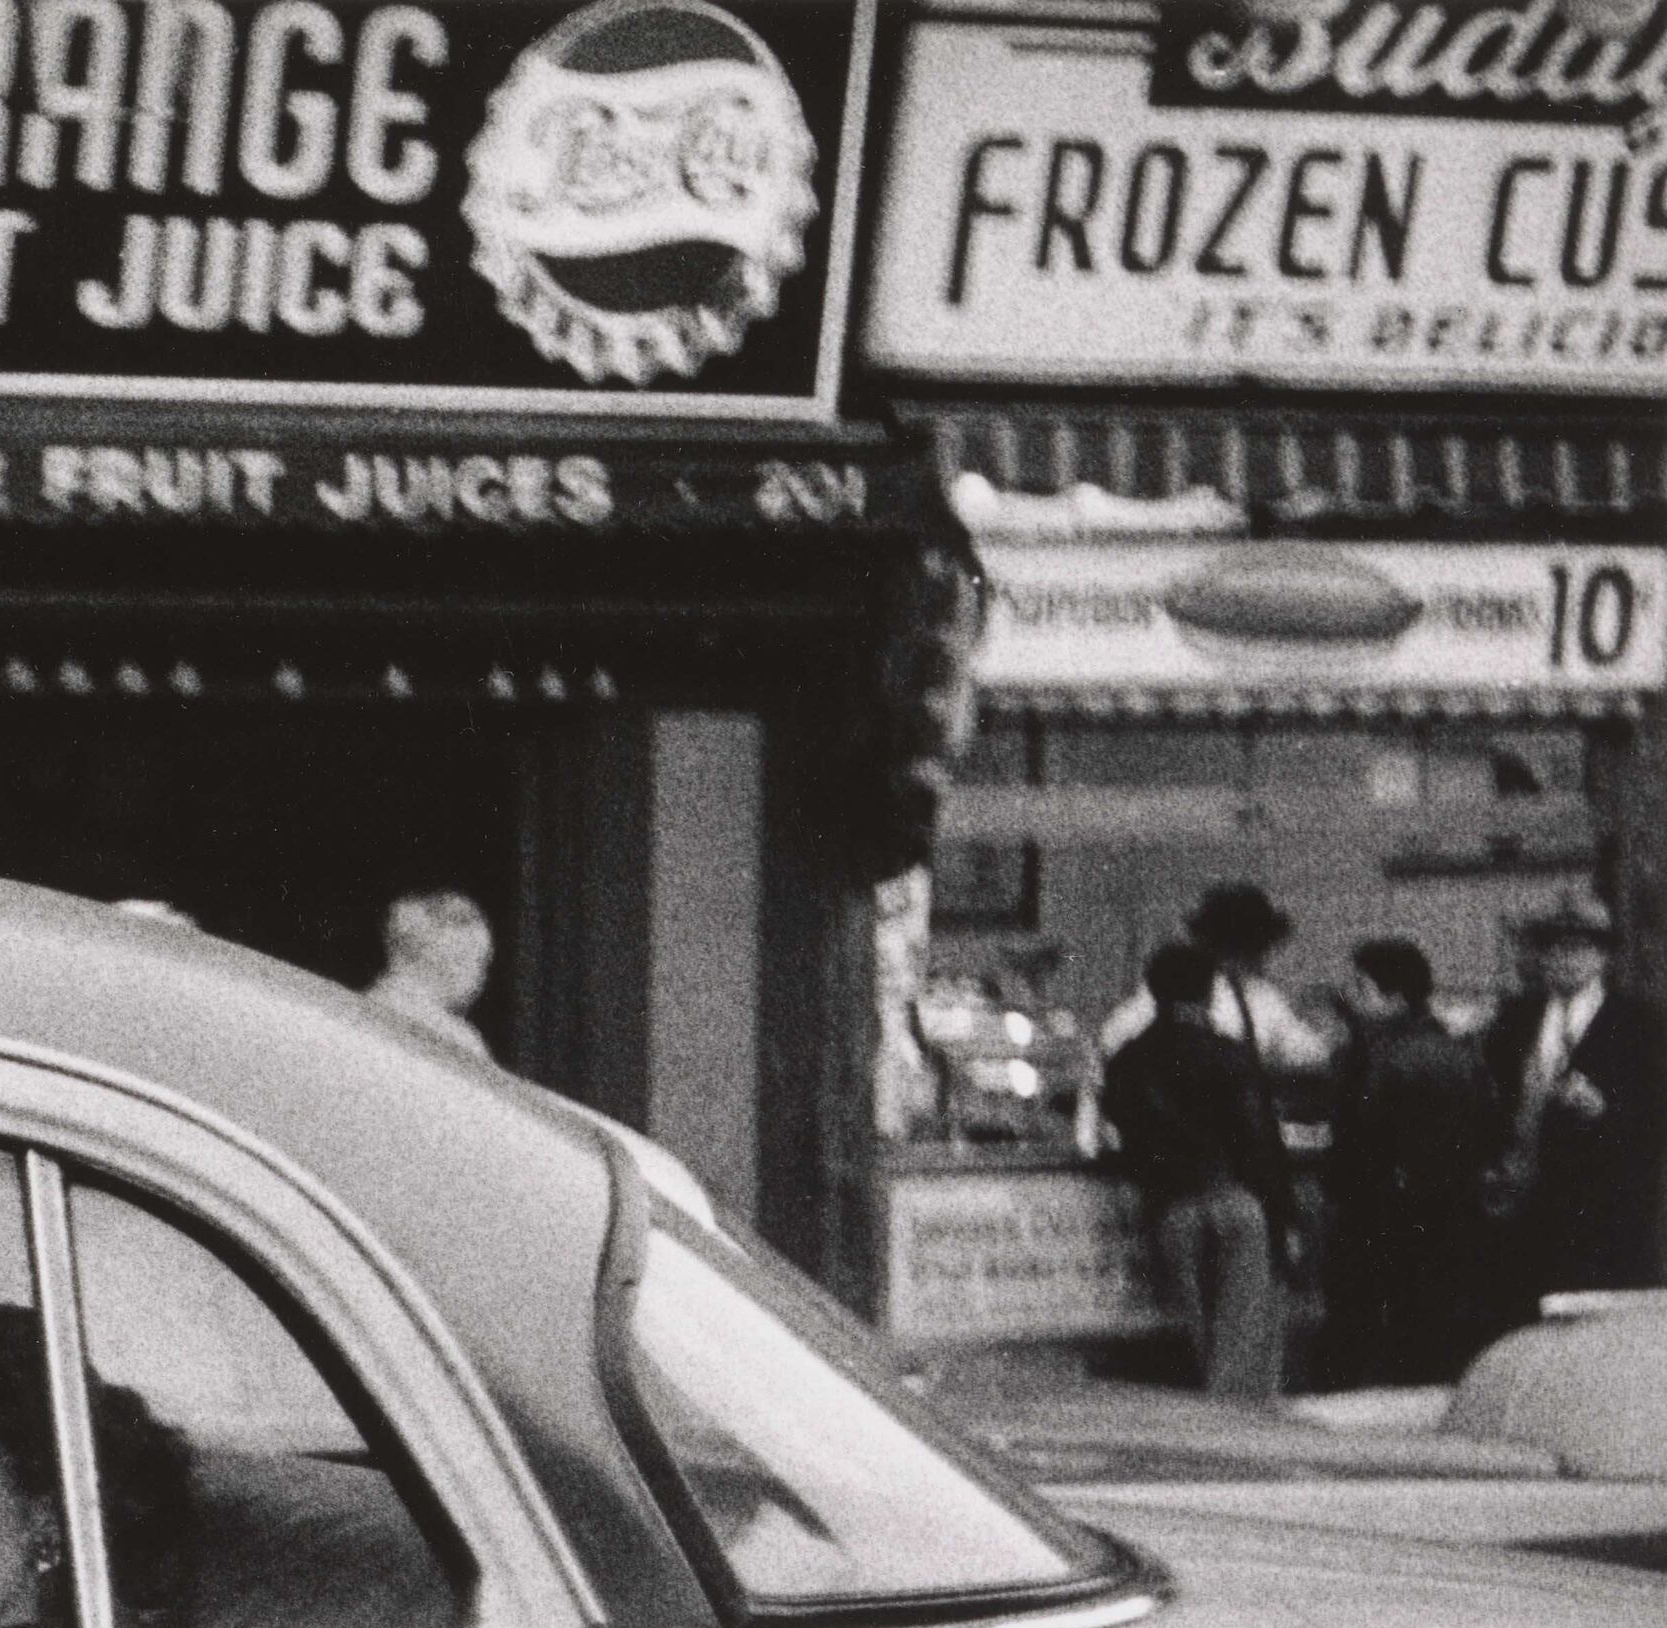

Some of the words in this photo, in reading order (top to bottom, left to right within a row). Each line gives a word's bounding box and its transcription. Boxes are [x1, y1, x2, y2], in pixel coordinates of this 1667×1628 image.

[77, 213, 429, 340] JUICE
[947, 135, 1424, 305] FROZEN
[41, 440, 287, 522] FRUIT
[315, 450, 617, 526] JUICES
